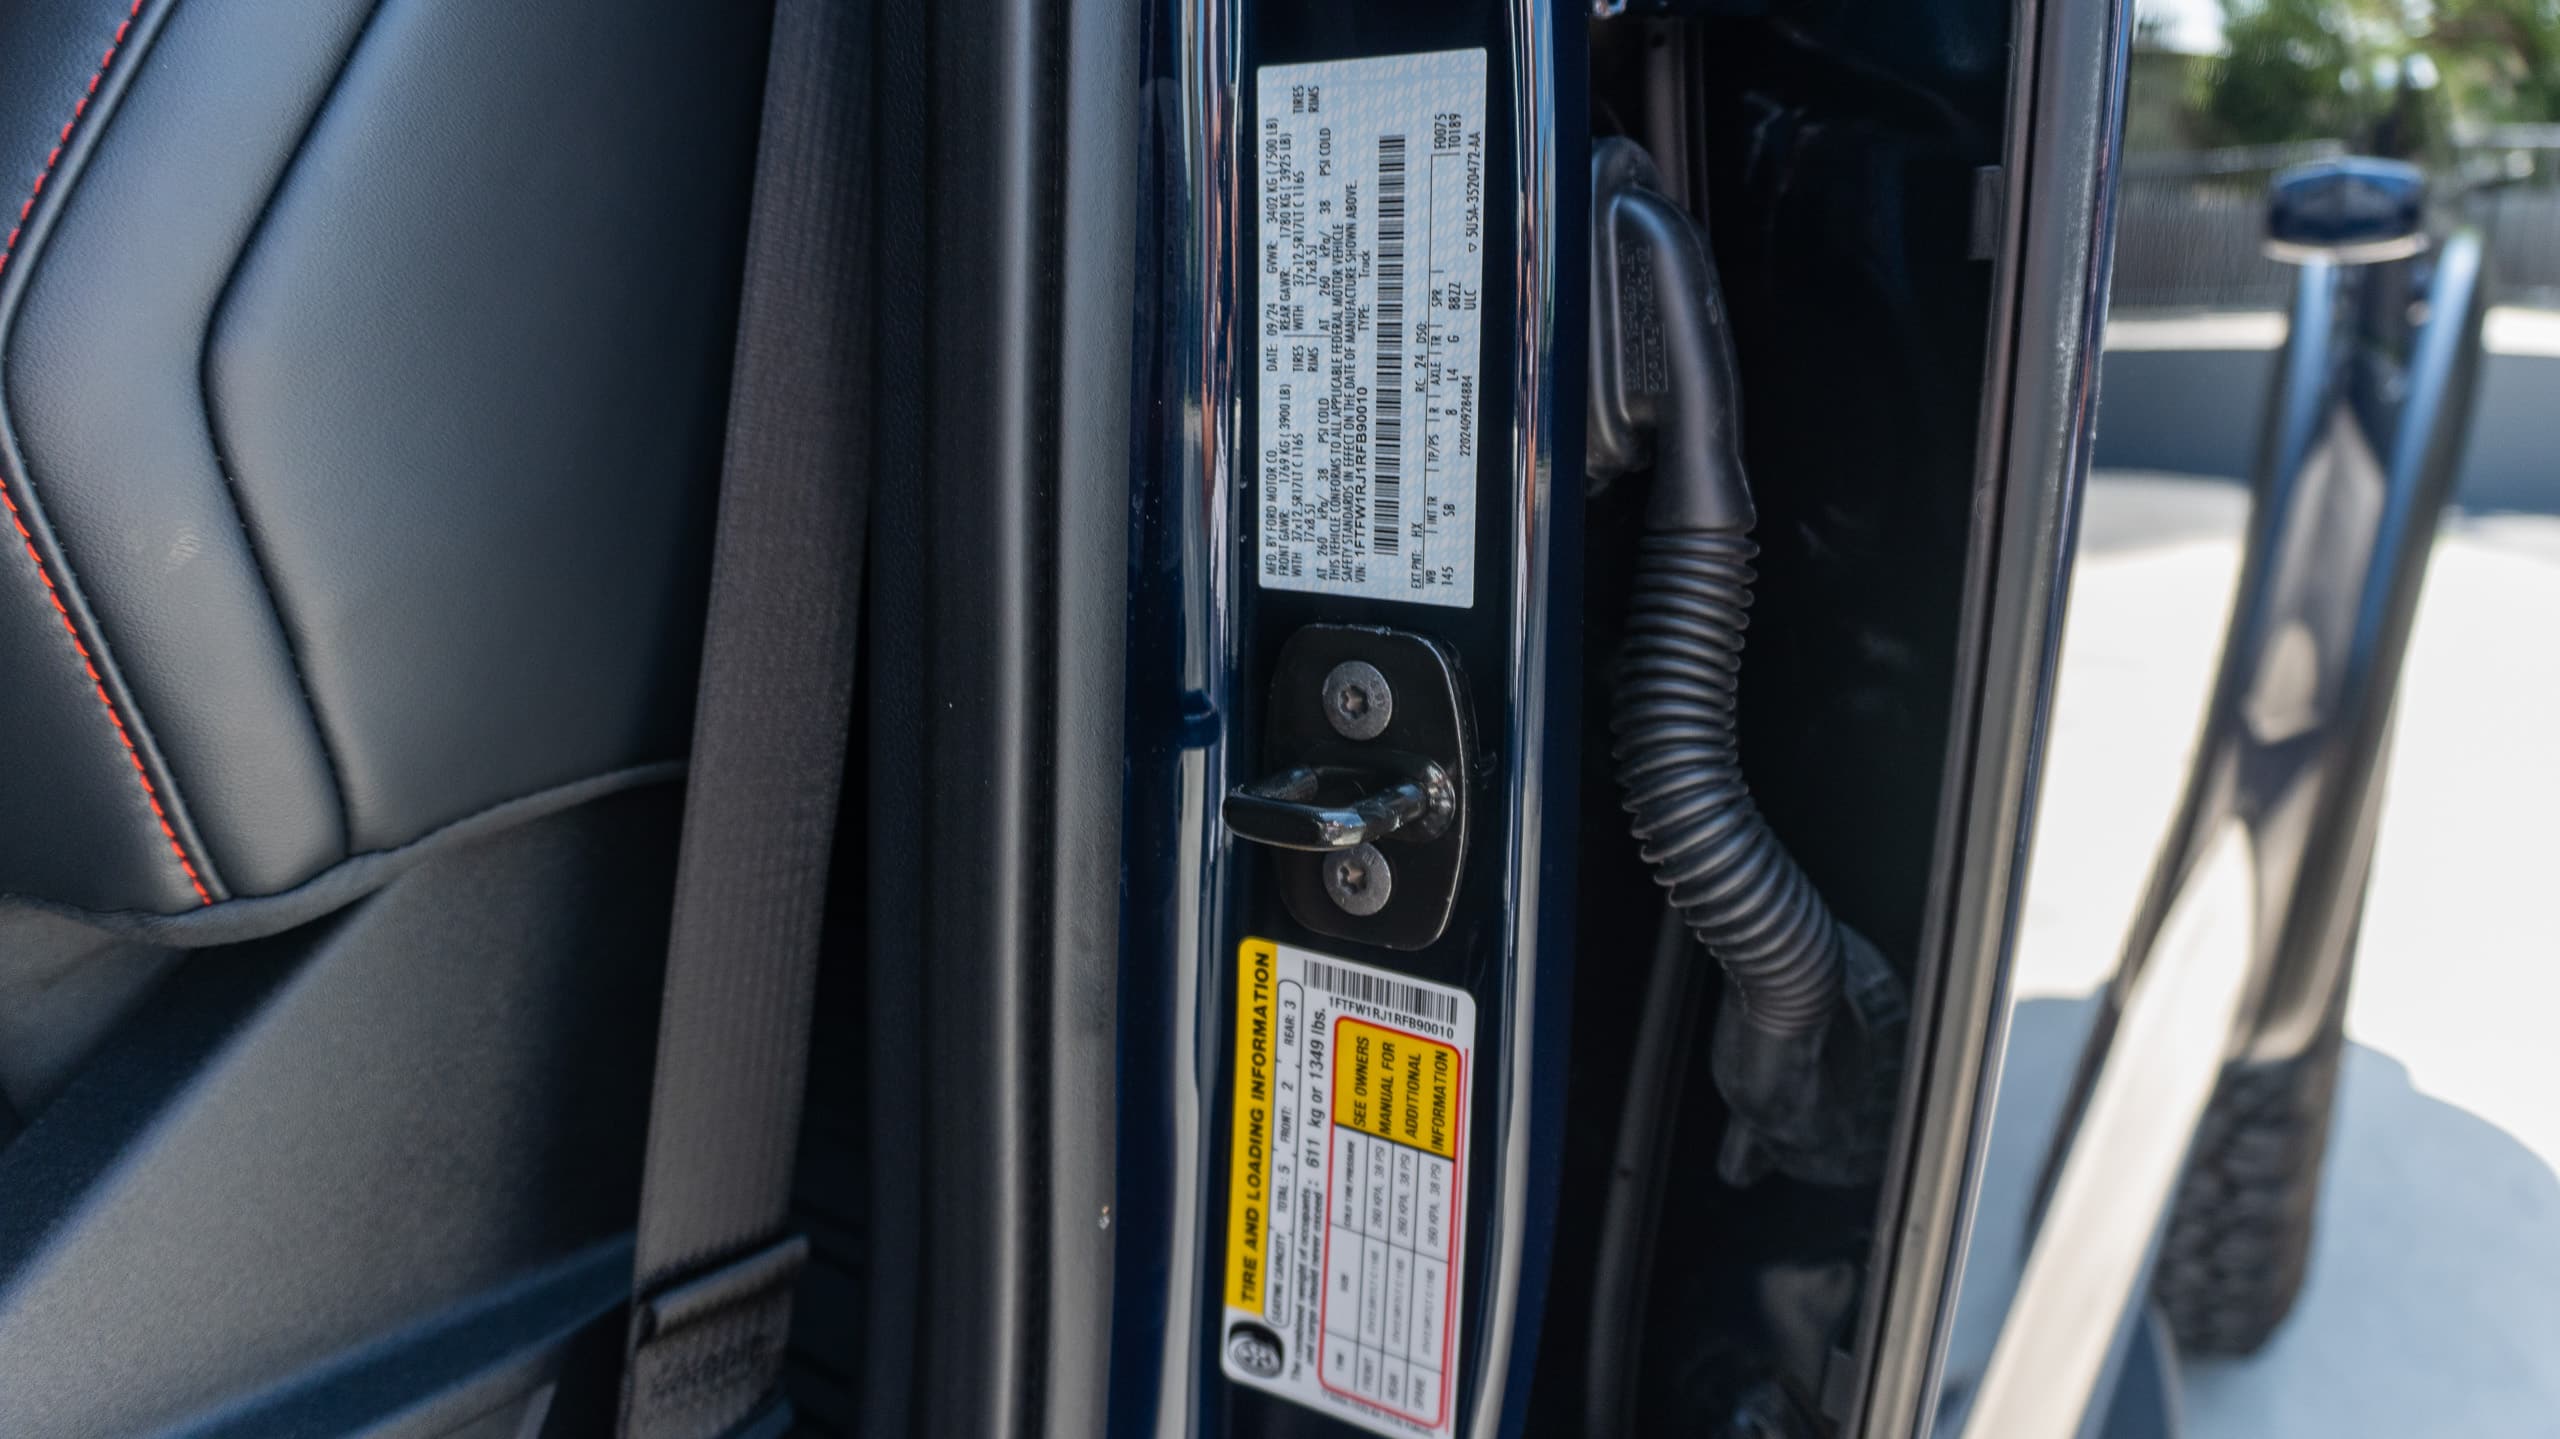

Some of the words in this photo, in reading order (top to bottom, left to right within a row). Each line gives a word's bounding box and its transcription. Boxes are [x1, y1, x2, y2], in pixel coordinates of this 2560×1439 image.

[1292, 85, 1304, 114] TIRES
[1308, 86, 1319, 113] RIMS
[1319, 128, 1330, 156] COLD
[1448, 113, 1462, 149] T0189
[1266, 139, 1278, 166] 7500
[1280, 154, 1291, 182] 3925
[1319, 160, 1330, 176] PSI
[1266, 178, 1278, 193] KG
[1293, 170, 1304, 196] 116S
[1266, 196, 1278, 224] 3402
[1280, 194, 1290, 208] KG
[1319, 200, 1331, 215] 38
[1345, 180, 1357, 219] ABOVE.
[1280, 212, 1290, 238] 1780
[1332, 224, 1344, 266] VEHICLE
[1345, 223, 1357, 262] SHOWN
[1358, 250, 1371, 278] Truck
[1319, 276, 1330, 296] 260
[1332, 270, 1343, 306] MOTOR
[1432, 288, 1443, 308] SPR
[1448, 282, 1462, 310] 88ZZ
[1344, 267, 1356, 344] MANUFACTURE
[1464, 289, 1477, 310] ULC
[1266, 304, 1279, 336] 09/24
[1280, 304, 1290, 331] REAR
[1293, 305, 1304, 331] WITH
[1319, 318, 1330, 332] AT
[1332, 310, 1343, 354] FEDERAL
[1431, 335, 1442, 347] TR
[1448, 335, 1460, 343] G
[1292, 345, 1304, 373] TIRES
[1308, 347, 1318, 372] RIMS
[1344, 346, 1356, 360] OF
[1414, 354, 1426, 368] 24
[1344, 364, 1355, 390] DATE
[1430, 362, 1442, 386] AXLE
[1446, 368, 1459, 382] L4
[1331, 357, 1342, 418] APPLICABLE
[1318, 398, 1329, 424] COLD
[1344, 393, 1355, 412] THE
[1279, 404, 1290, 430] 3900
[1343, 415, 1355, 430] ON
[1460, 376, 1472, 457] 2202409284884
[1318, 428, 1329, 444] PSI
[1331, 422, 1342, 438] ALL
[1266, 446, 1277, 463] CO.
[1280, 440, 1290, 455] KG
[1292, 433, 1303, 458] 116S
[1330, 441, 1341, 454] TO
[1343, 434, 1354, 467] EFFECT
[1428, 434, 1440, 463] TP/PS
[1266, 466, 1277, 502] MOTOR
[1279, 458, 1290, 484] 1769
[1318, 468, 1328, 481] 38
[1343, 471, 1354, 482] IN
[1354, 386, 1368, 558] 1FTFW1RJ1RFB90010
[1330, 458, 1341, 513] CONFORMS
[1427, 496, 1438, 506] TR
[1266, 506, 1277, 532] FORD
[1342, 485, 1354, 544] STANDARDS
[1427, 508, 1438, 525] INT
[1266, 536, 1277, 547] BY
[1330, 516, 1341, 556] VEHICLE
[1410, 522, 1424, 538] HX
[1317, 536, 1328, 556] 260
[1266, 552, 1277, 576] MFD.
[1279, 544, 1289, 576] FRONT
[1292, 552, 1302, 577] WITH
[1329, 560, 1340, 580] THIS
[1342, 548, 1353, 582] SAFETY
[1354, 562, 1366, 584] VIN:
[1317, 568, 1328, 580] AT
[1411, 572, 1422, 589] EXT
[1426, 570, 1436, 584] WB
[1442, 566, 1454, 586] 145
[1284, 1000, 1296, 1010] 3
[1328, 996, 1454, 1039] 1FTFW1RJ1RFB90010
[1251, 952, 1269, 1102] INFORMATION
[1284, 1014, 1295, 1046] REAR:
[1310, 1008, 1325, 1036] lbs.
[1309, 1039, 1324, 1080] 1349
[1354, 1036, 1370, 1096] OWNERS
[1382, 1042, 1396, 1072] FOR
[1281, 1081, 1293, 1092] 2
[1311, 1087, 1323, 1104] or
[1405, 1053, 1422, 1139] ADDITIONAL
[1353, 1100, 1366, 1128] SEE
[1378, 1076, 1394, 1136] MANUAL
[1431, 1050, 1448, 1152] INFORMATION
[1280, 1105, 1292, 1144] FRONT:
[1307, 1108, 1326, 1128] kg
[1246, 1108, 1264, 1201] LOADING
[1306, 1138, 1320, 1168] 611
[1375, 1146, 1386, 1162] PSI
[1400, 1153, 1411, 1170] PSI
[1277, 1164, 1290, 1174] 5
[1374, 1164, 1384, 1178] 38
[1400, 1172, 1410, 1186] 38
[1430, 1163, 1442, 1180] PSI
[1430, 1182, 1441, 1196] 38
[1243, 1207, 1259, 1253] AND
[1241, 1256, 1257, 1304] TIRE
